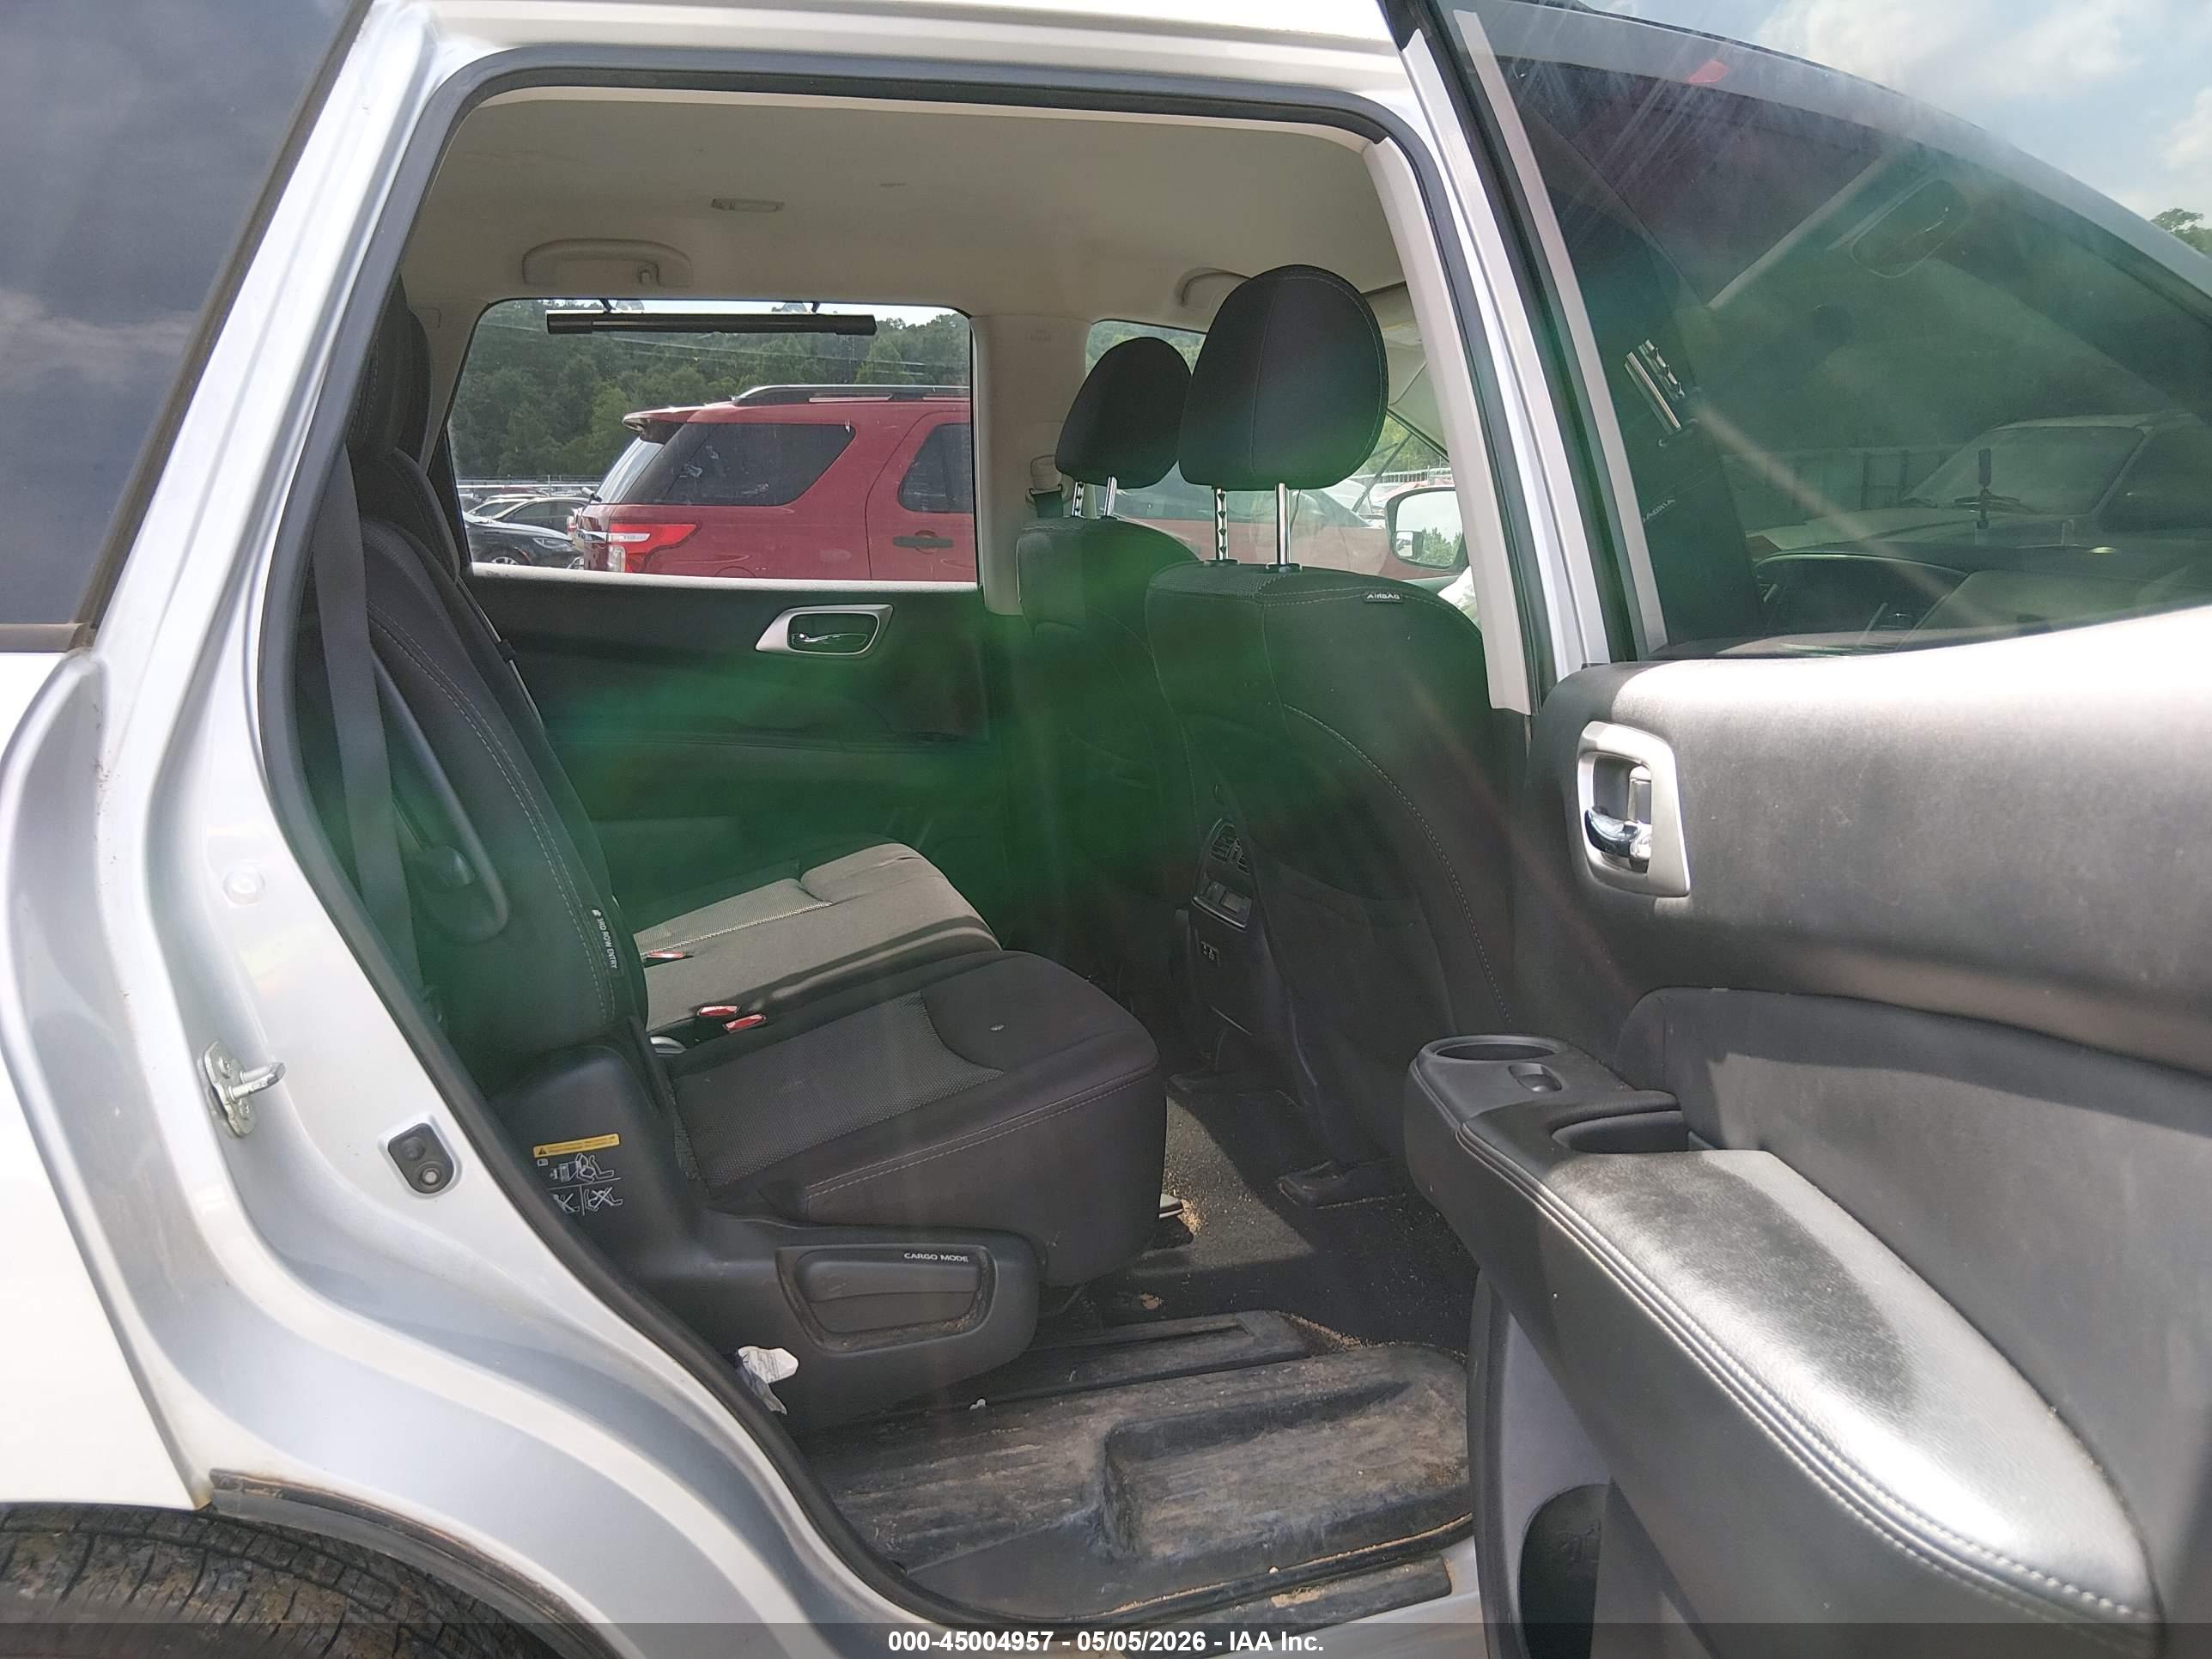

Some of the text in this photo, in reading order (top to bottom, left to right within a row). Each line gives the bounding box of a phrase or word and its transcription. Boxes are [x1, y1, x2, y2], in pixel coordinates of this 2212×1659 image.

[601, 931, 612, 947] ROW
[606, 948, 618, 969] ENTRY
[903, 1252, 969, 1262] CARGO MODE
